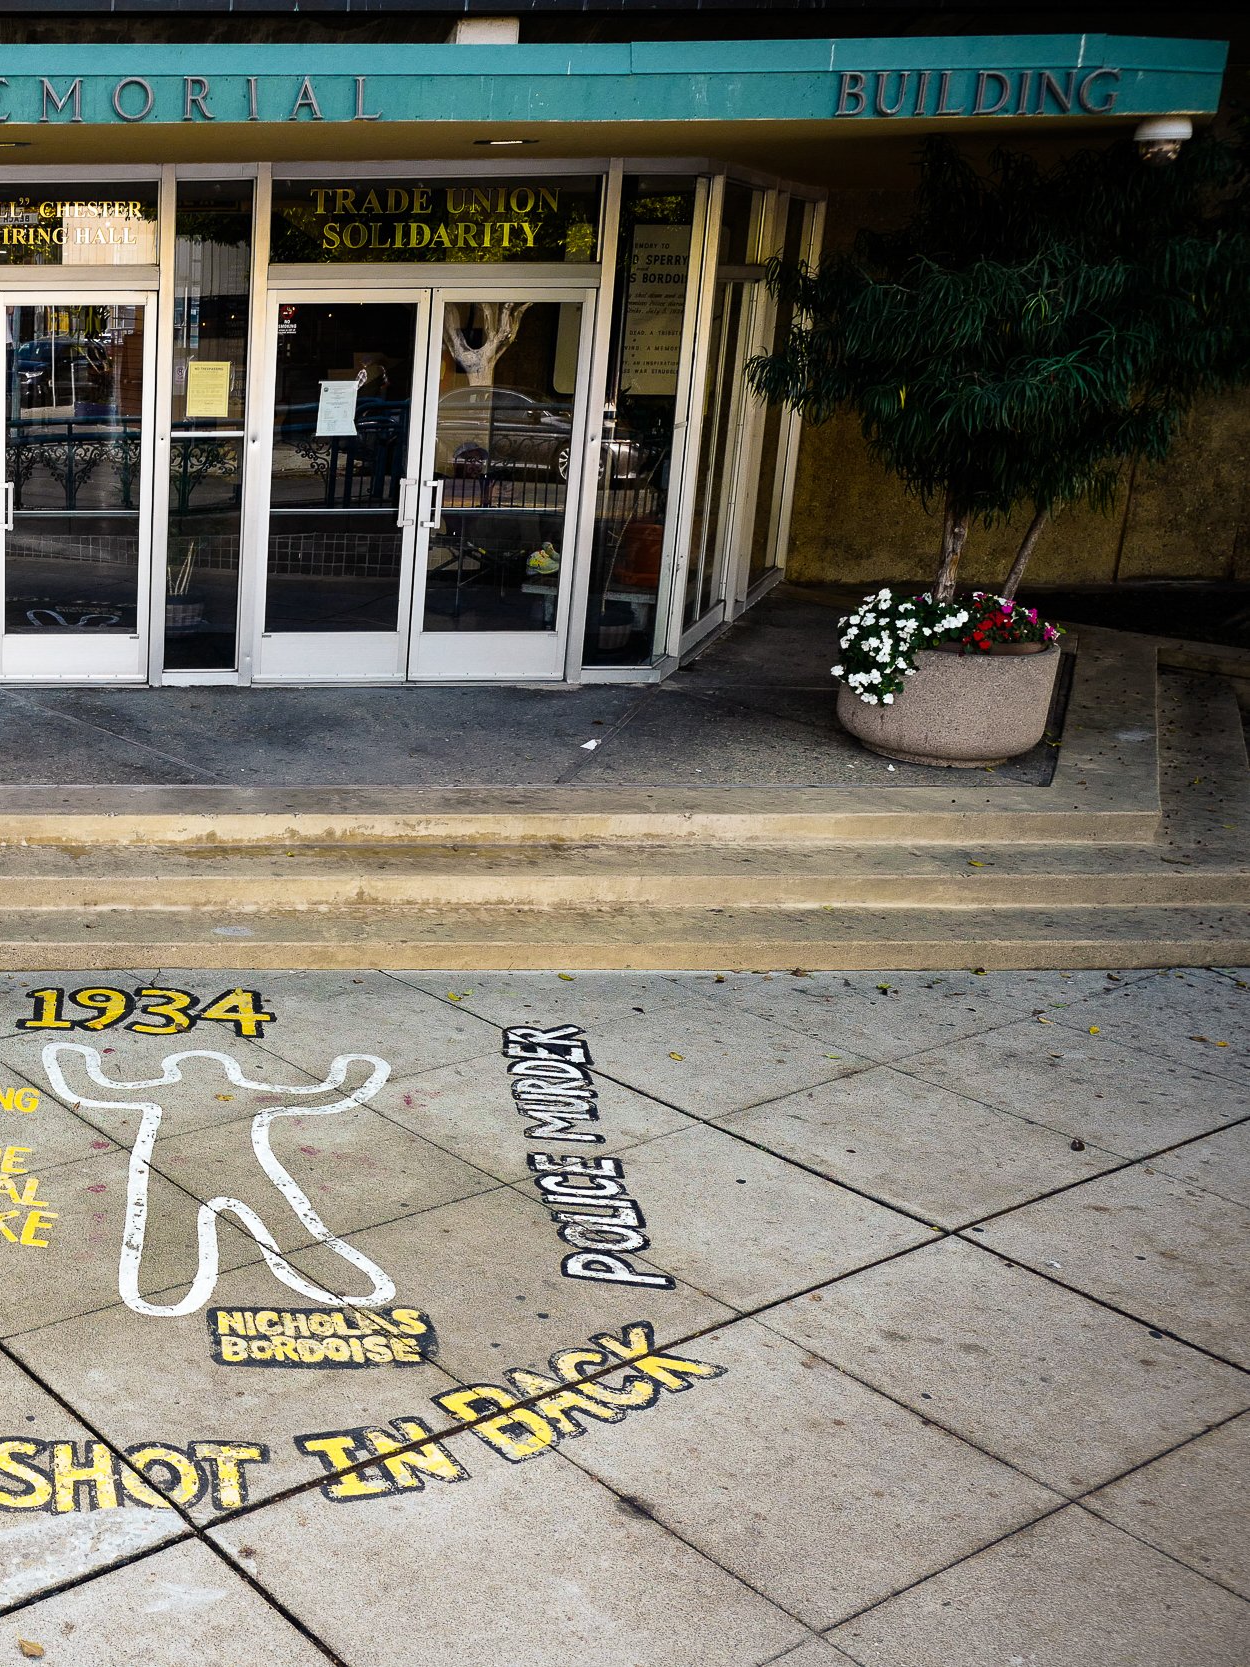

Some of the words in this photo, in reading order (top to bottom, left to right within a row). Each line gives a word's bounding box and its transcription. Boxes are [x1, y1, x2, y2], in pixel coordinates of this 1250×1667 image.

[835, 67, 1122, 117] BUILDING
[39, 200, 143, 219] CHESTER
[310, 188, 433, 214] TRADE
[445, 187, 561, 214] UNION
[75, 227, 136, 245] HALL
[322, 222, 542, 249] SOLIDARITY
[645, 254, 688, 266] SPERRY
[17, 985, 277, 1039] 1934
[502, 1024, 607, 1144] MURDER
[526, 1151, 676, 1290] POLICE
[216, 1308, 427, 1336] NICHOLAS
[294, 1415, 472, 1503] IN
[430, 1321, 728, 1464] BACK
